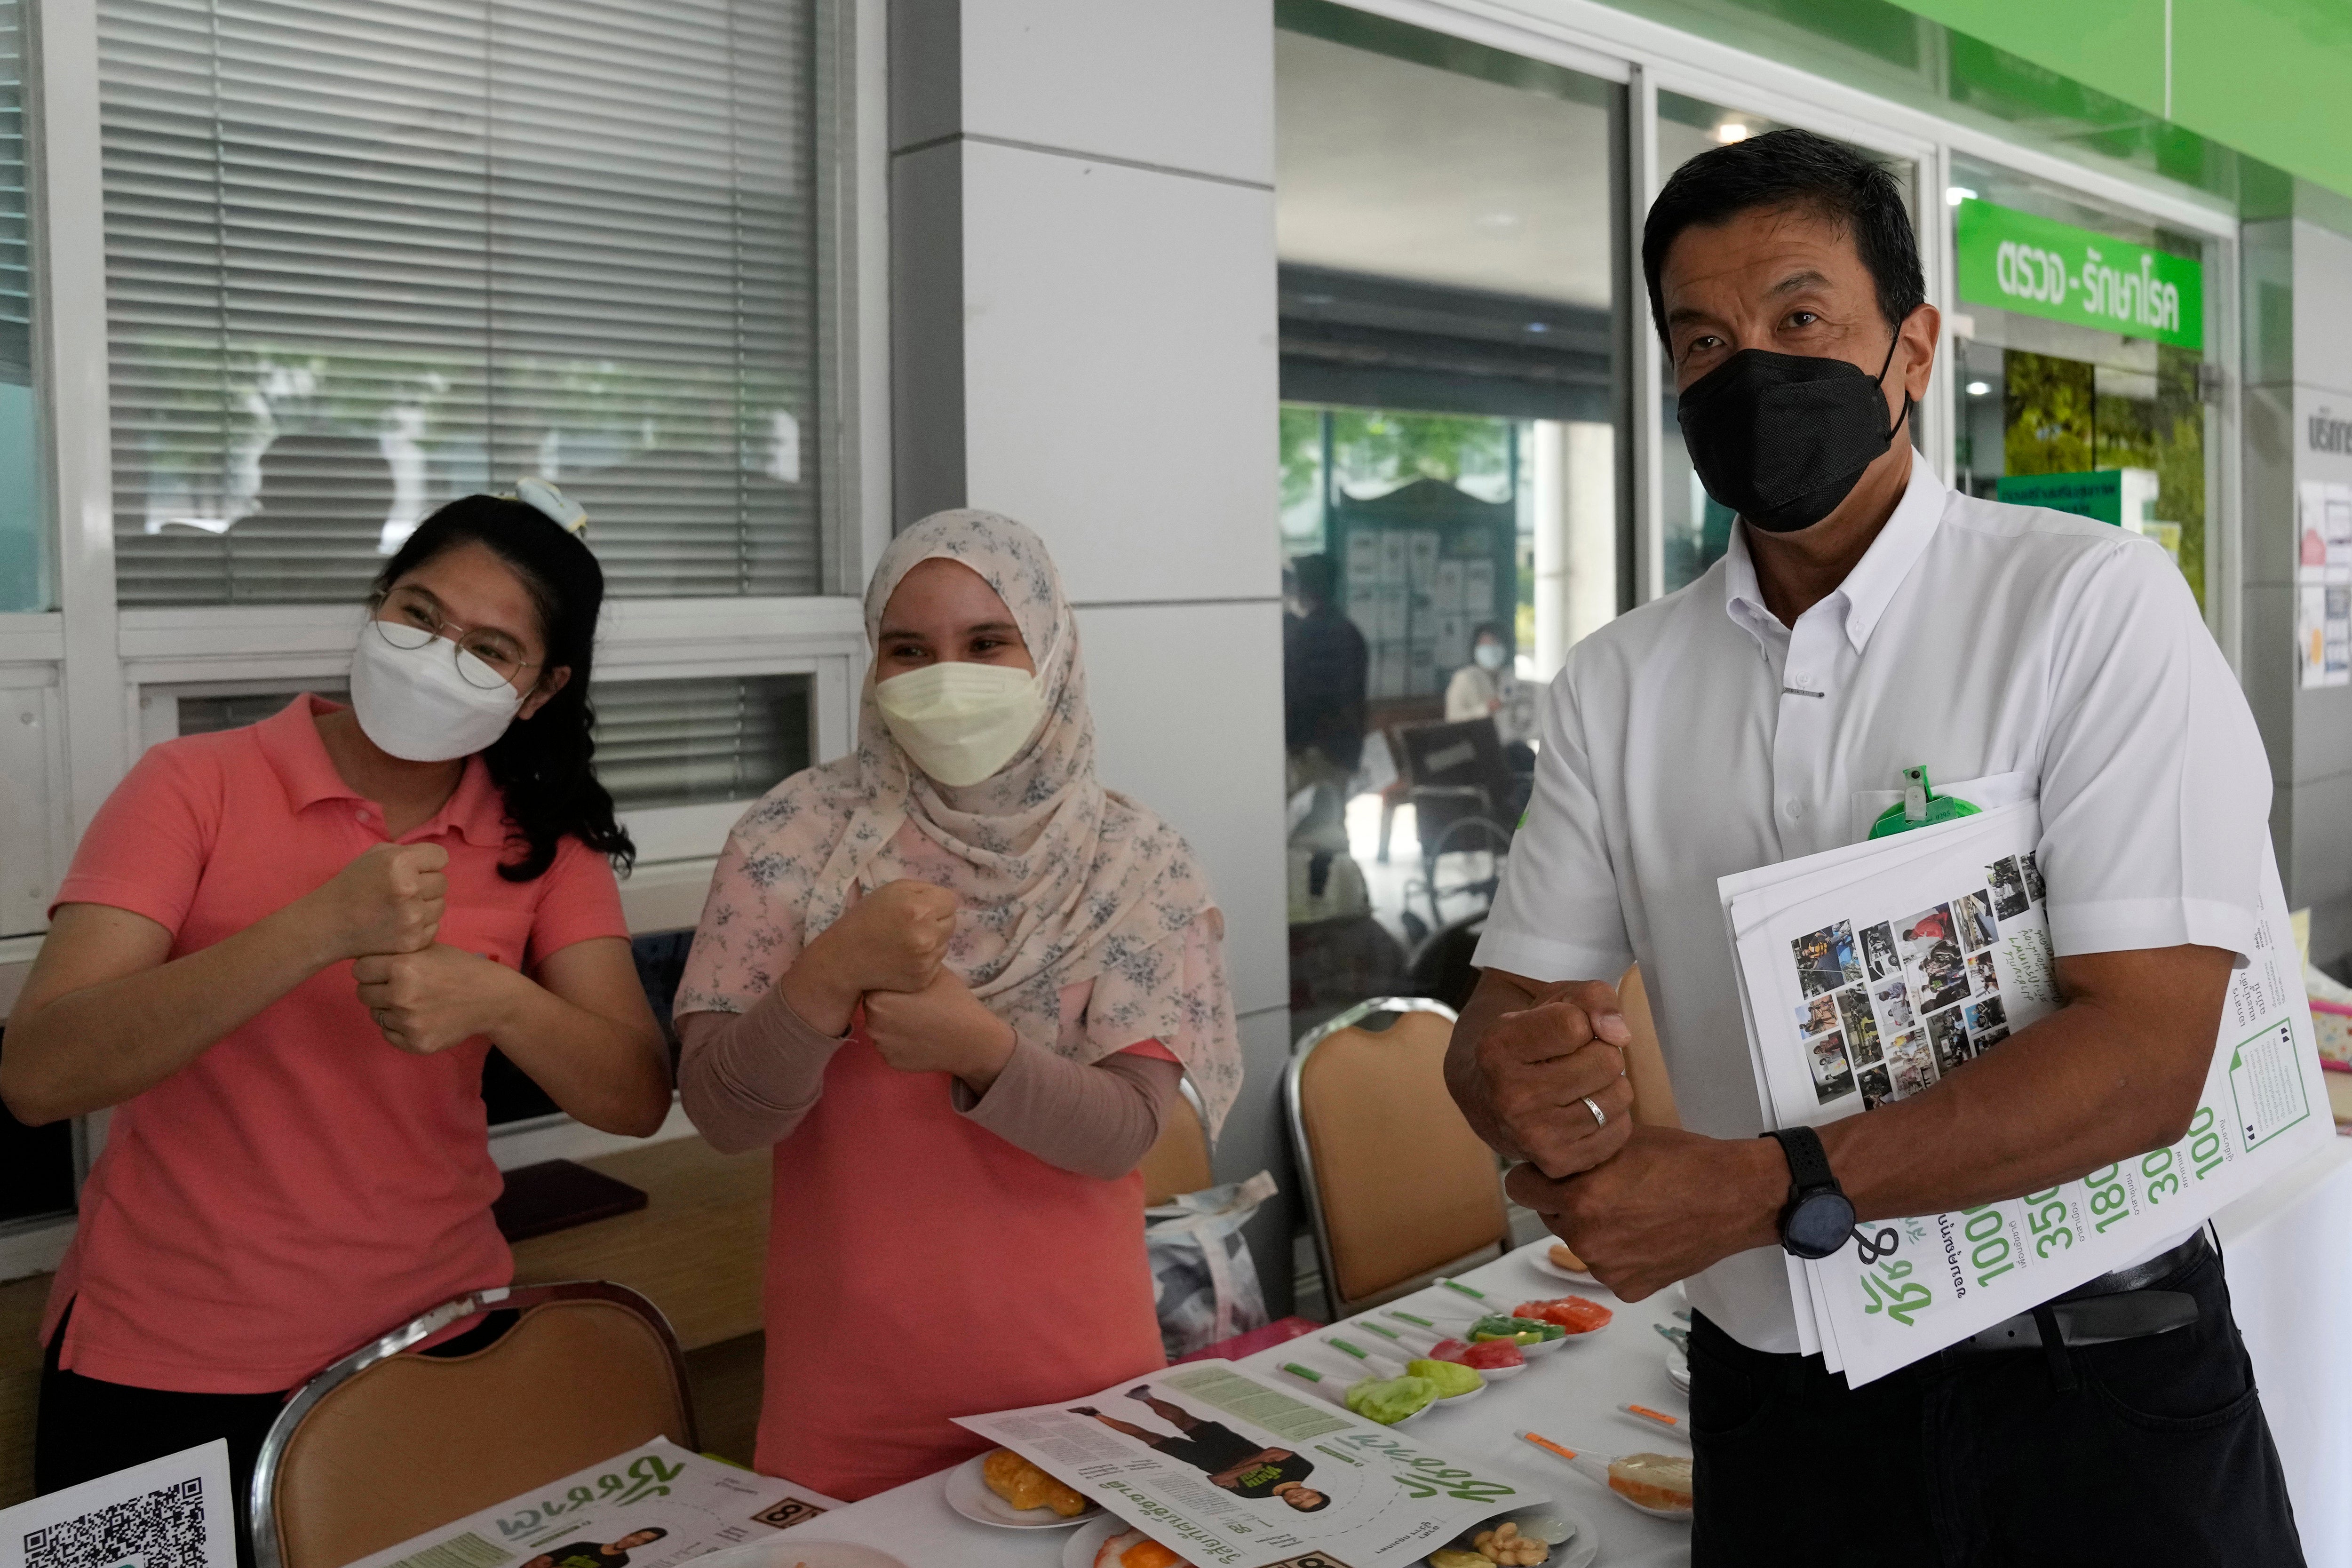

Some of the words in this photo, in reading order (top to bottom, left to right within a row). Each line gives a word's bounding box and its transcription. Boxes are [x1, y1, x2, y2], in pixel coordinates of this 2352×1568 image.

[2232, 987, 2245, 1027] เอกสาร
[2239, 972, 2255, 1021] แนะนำตัว
[2249, 982, 2265, 1014] ฉบับนี้
[2218, 1119, 2234, 1161] ผู้เชี่ยวชาญ
[2141, 1147, 2178, 1204] 30
[2175, 1151, 2189, 1188] สภากาแฟ
[2126, 1173, 2139, 1215] อาสาชุมชน
[2071, 1202, 2085, 1242] อาสาเมือง
[1960, 1203, 2014, 1287] 100
[2008, 1220, 2027, 1268] เพื่อนชัชชาติ
[767, 1504, 803, 1522] 8
